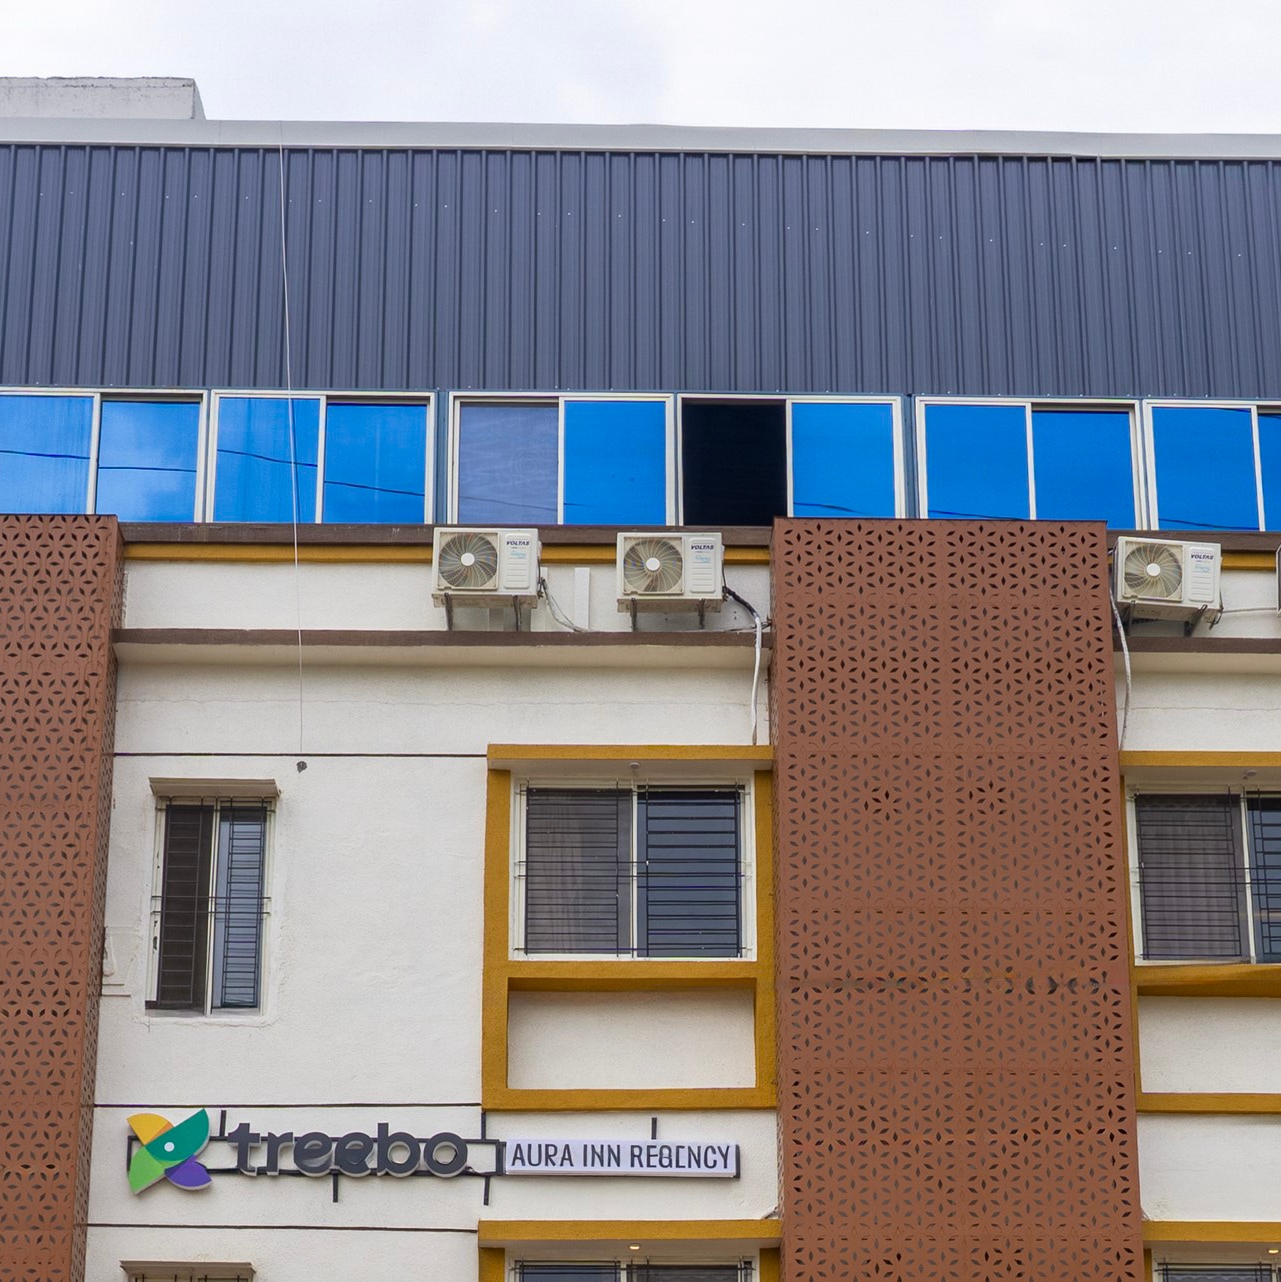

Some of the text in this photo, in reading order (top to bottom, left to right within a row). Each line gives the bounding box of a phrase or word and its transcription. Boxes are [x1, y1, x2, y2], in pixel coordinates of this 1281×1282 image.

[228, 1122, 468, 1178] treebo
[511, 1143, 730, 1169] AURA INN REGENCY
